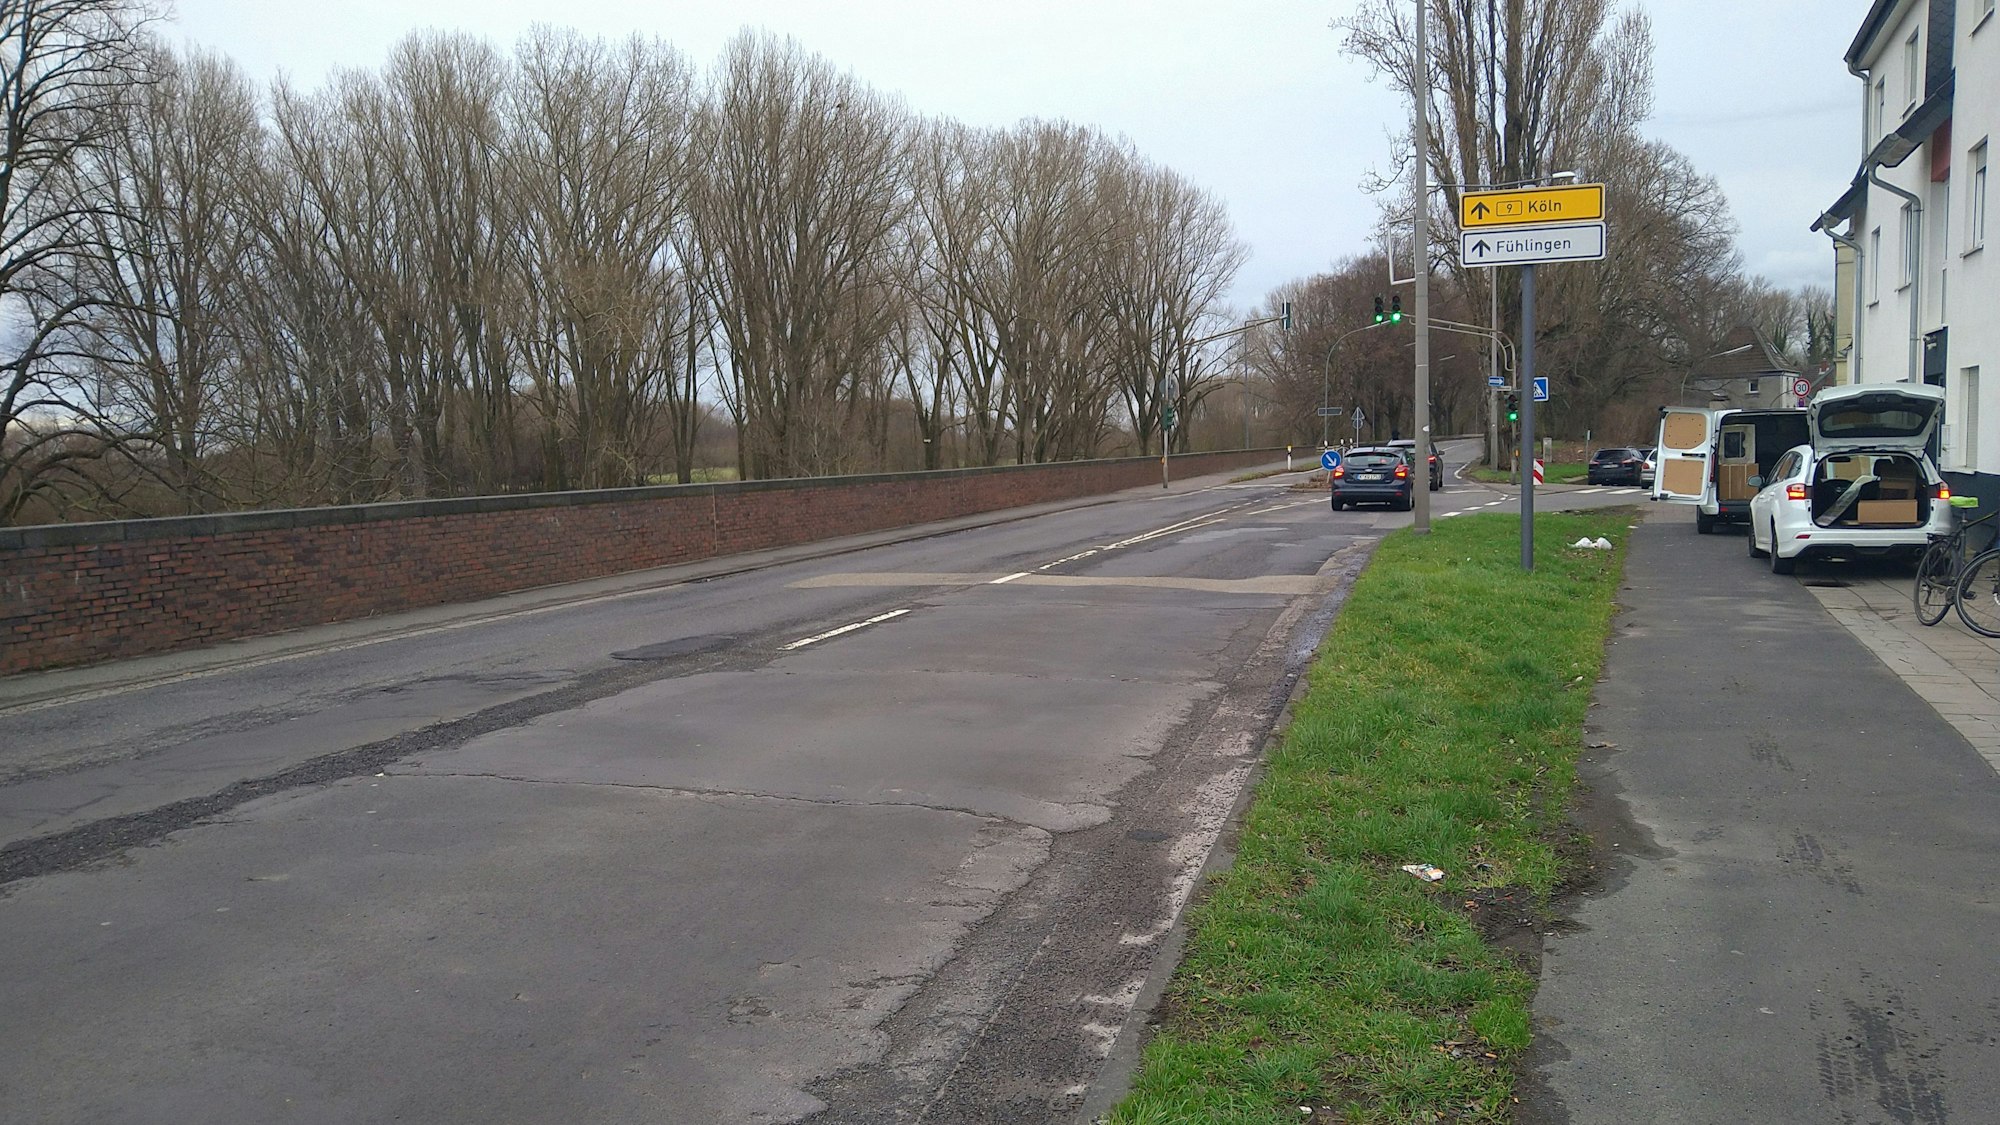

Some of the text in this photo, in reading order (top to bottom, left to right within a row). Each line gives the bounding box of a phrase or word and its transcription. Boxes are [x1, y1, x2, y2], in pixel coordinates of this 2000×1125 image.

[1506, 200, 1562, 213] 9 Köln
[1496, 238, 1571, 253] Fühlingen
[1796, 384, 1806, 392] 30
